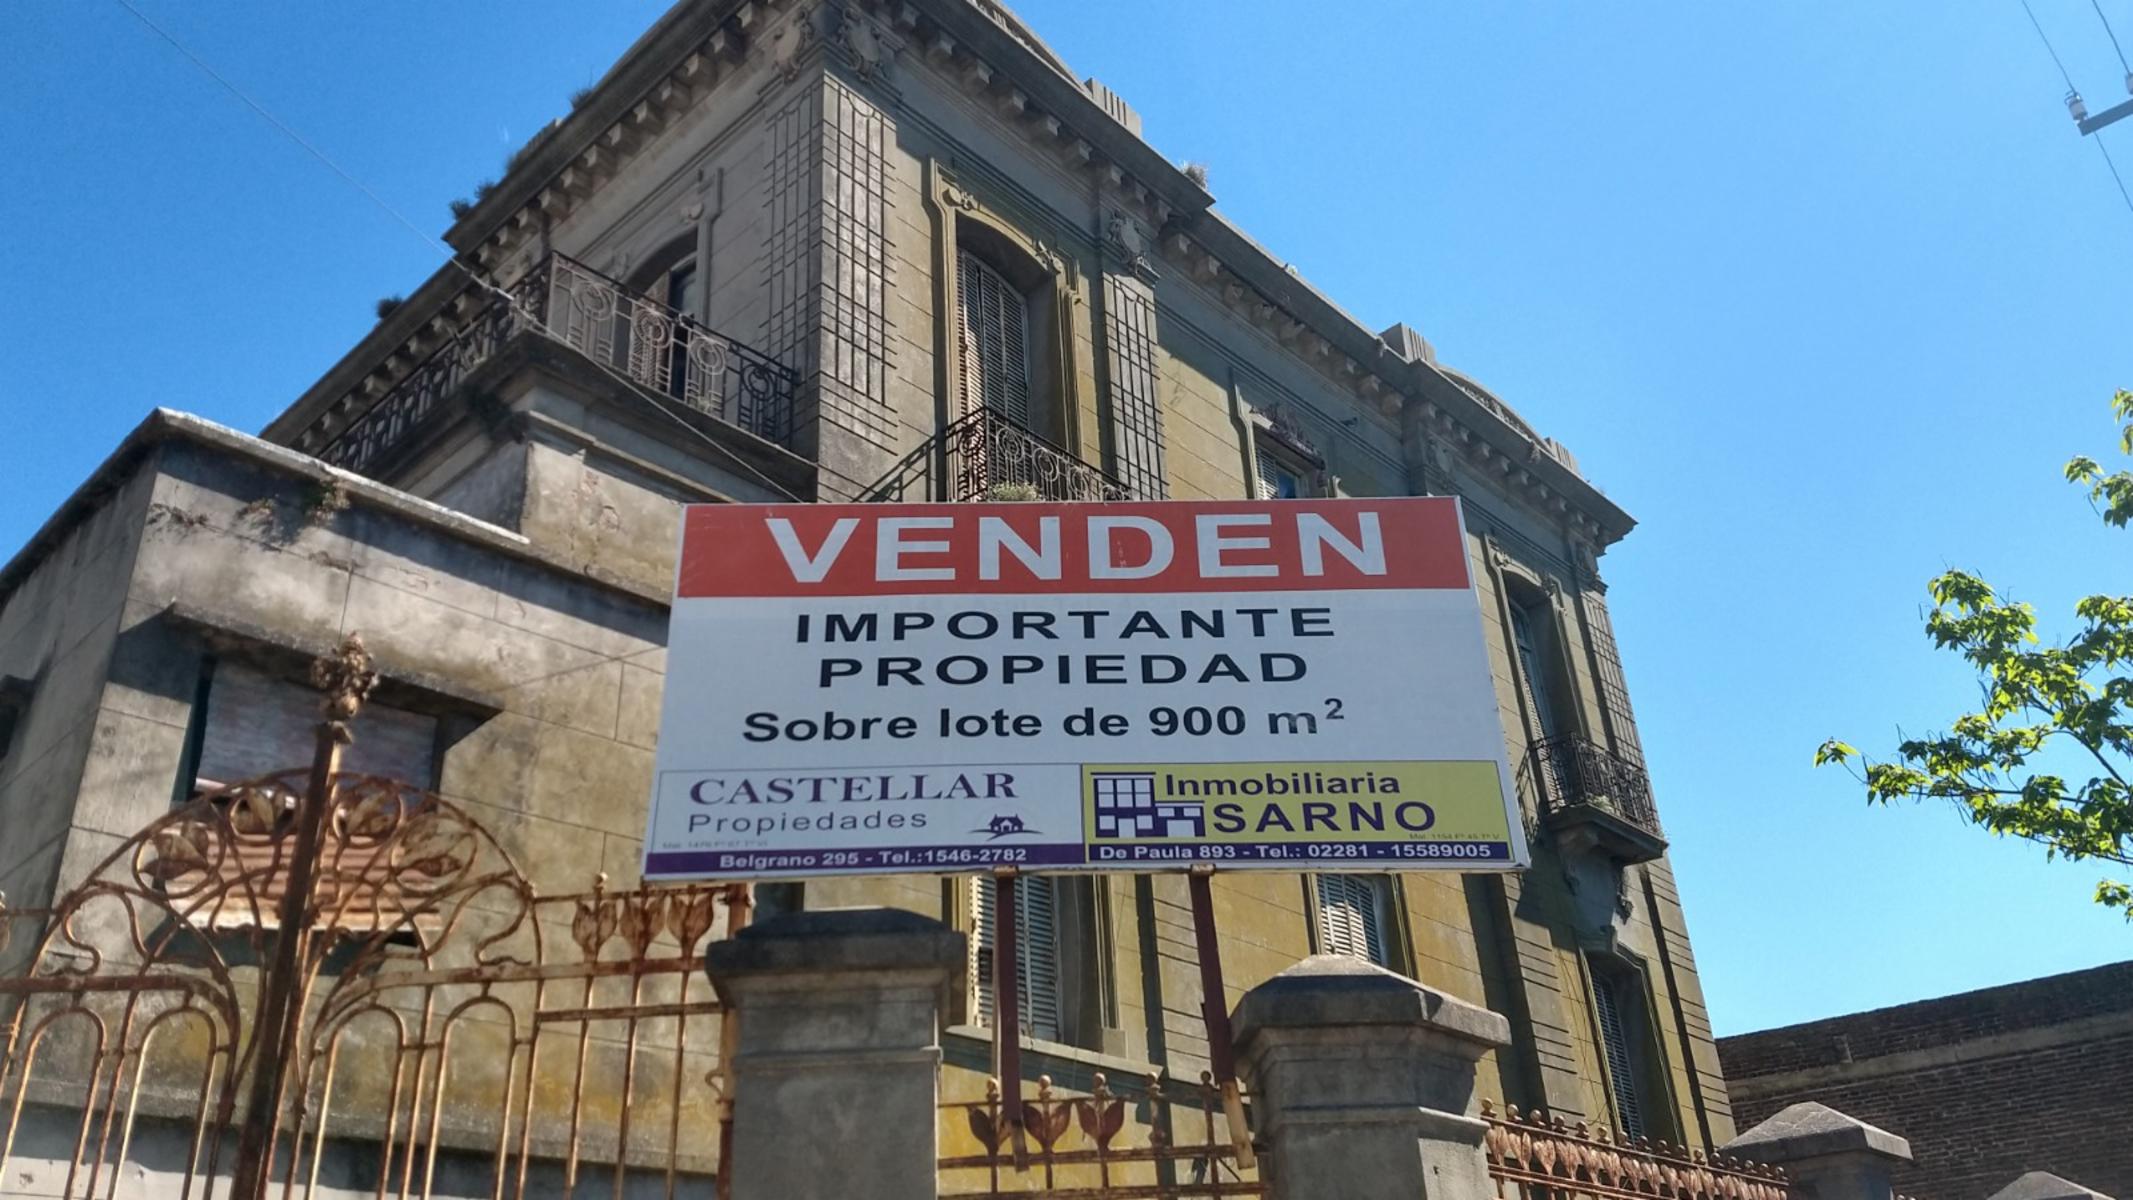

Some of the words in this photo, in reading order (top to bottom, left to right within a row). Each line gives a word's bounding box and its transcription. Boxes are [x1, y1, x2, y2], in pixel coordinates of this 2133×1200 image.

[765, 512, 1387, 583] VENDEN
[797, 608, 1335, 643] IMPORTANTE
[820, 653, 1308, 688] PROPIEDAD
[743, 711, 917, 742] Sobre
[940, 708, 1042, 738] lote
[1063, 707, 1129, 737] de
[1149, 705, 1246, 736] 900
[689, 772, 1020, 805] CASTELLAR
[1166, 772, 1400, 796] Inmobiliaria
[688, 810, 928, 836] Propiedades
[1213, 801, 1436, 833] SARNO
[720, 853, 816, 870] Belgrano
[822, 851, 859, 866] 295
[1100, 846, 1127, 859] De
[1134, 845, 1193, 859] Paula
[1199, 845, 1236, 858] 893
[1256, 845, 1301, 858] Tel.:
[1308, 844, 1368, 857] 02281
[1391, 844, 1491, 857] 15589005
